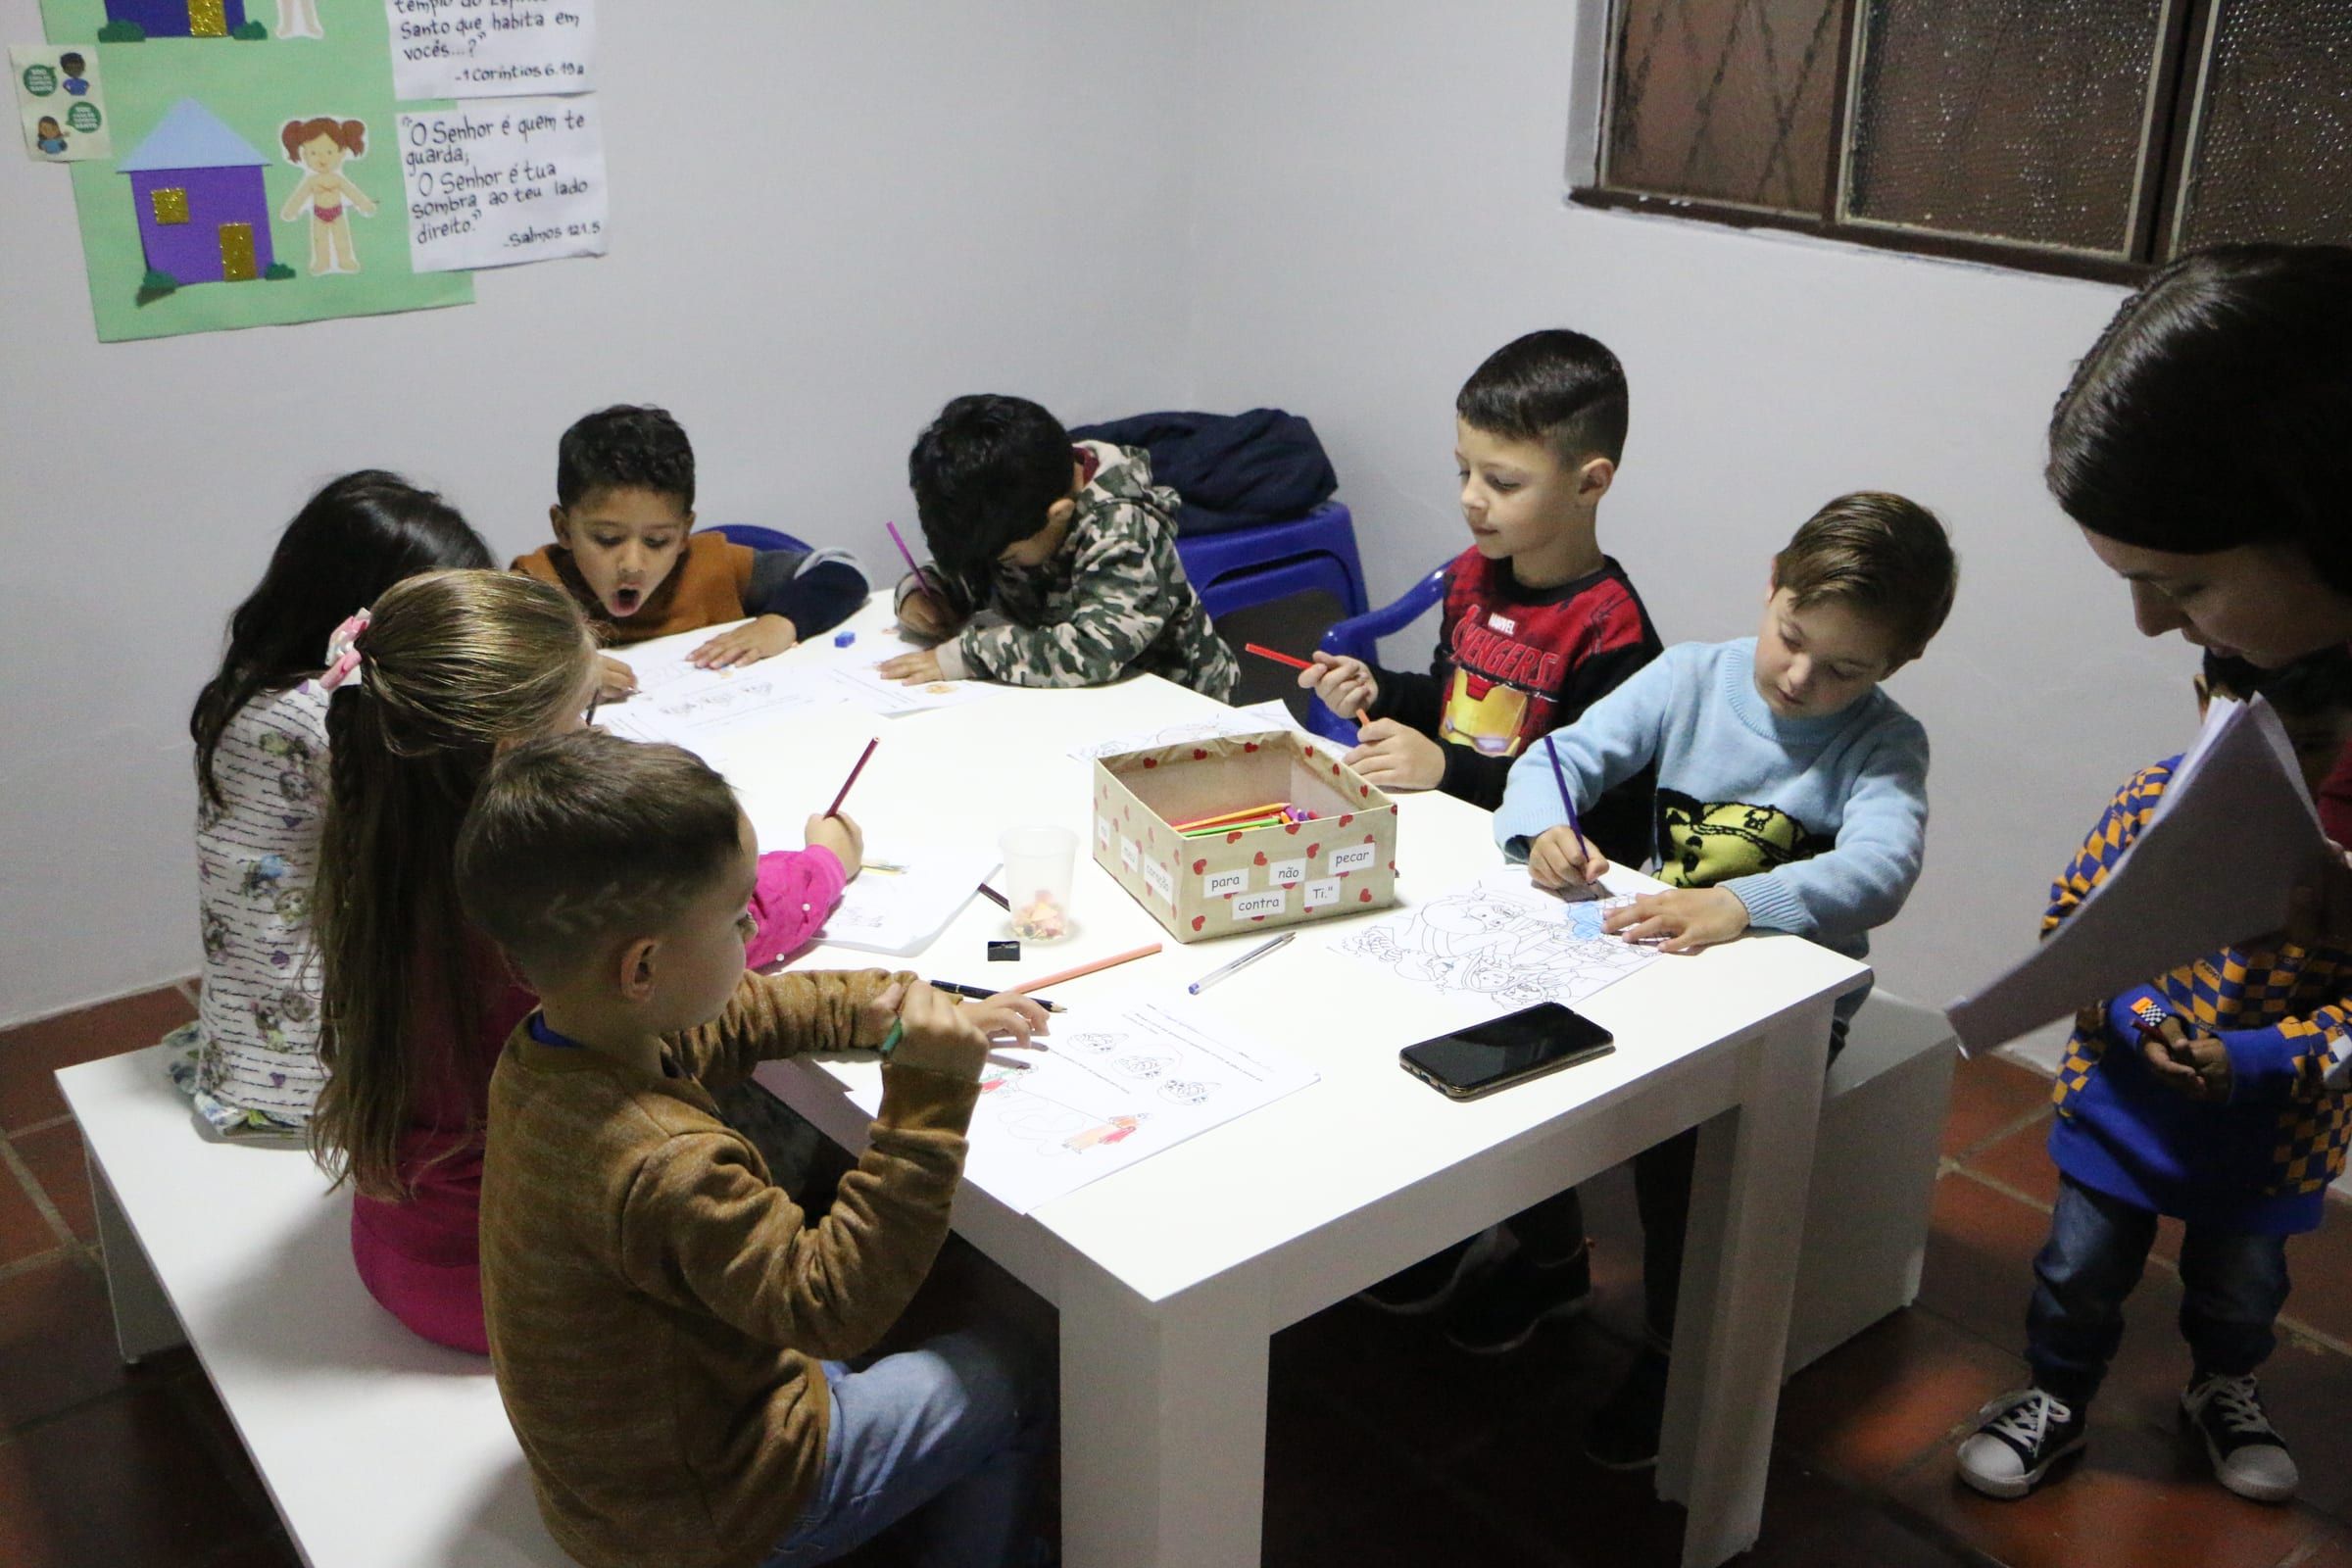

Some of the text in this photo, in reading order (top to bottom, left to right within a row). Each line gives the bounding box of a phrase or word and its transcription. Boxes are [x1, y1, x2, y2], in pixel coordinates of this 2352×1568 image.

[401, 11, 579, 39] Santo que habita em
[433, 116, 494, 144] Senhor
[502, 115, 511, 135] é
[518, 115, 557, 143] quem
[564, 110, 585, 129] te
[418, 161, 557, 197] O Senhor é tua
[412, 179, 588, 220] sombra ao teu lado
[1451, 604, 1561, 686] AVENGERS
[1211, 850, 1369, 891] para não pecar
[1238, 886, 1333, 911] contra Ti."
